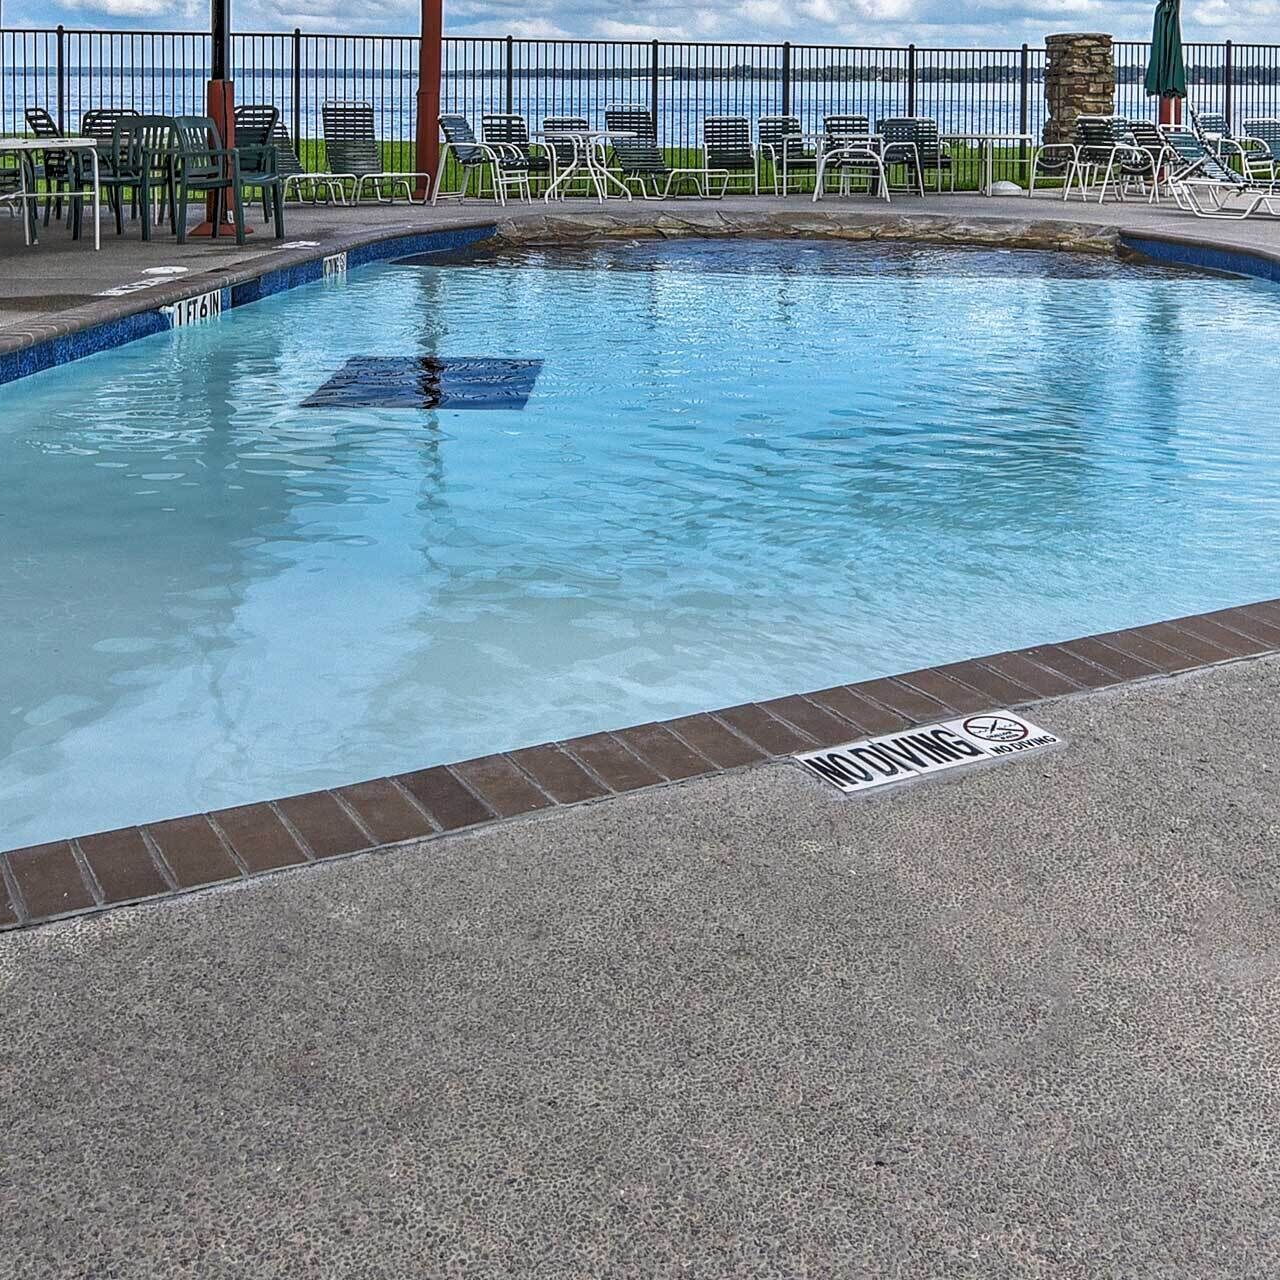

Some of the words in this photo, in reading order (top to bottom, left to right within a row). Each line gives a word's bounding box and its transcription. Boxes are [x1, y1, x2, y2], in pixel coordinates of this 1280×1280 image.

[177, 302, 183, 326] 1
[187, 299, 198, 326] FT
[200, 295, 208, 318] 6
[209, 290, 220, 317] IN
[803, 750, 875, 788] NO
[850, 728, 985, 777] DIVING
[989, 745, 1014, 755] NO
[1009, 735, 1057, 751] DIVING
